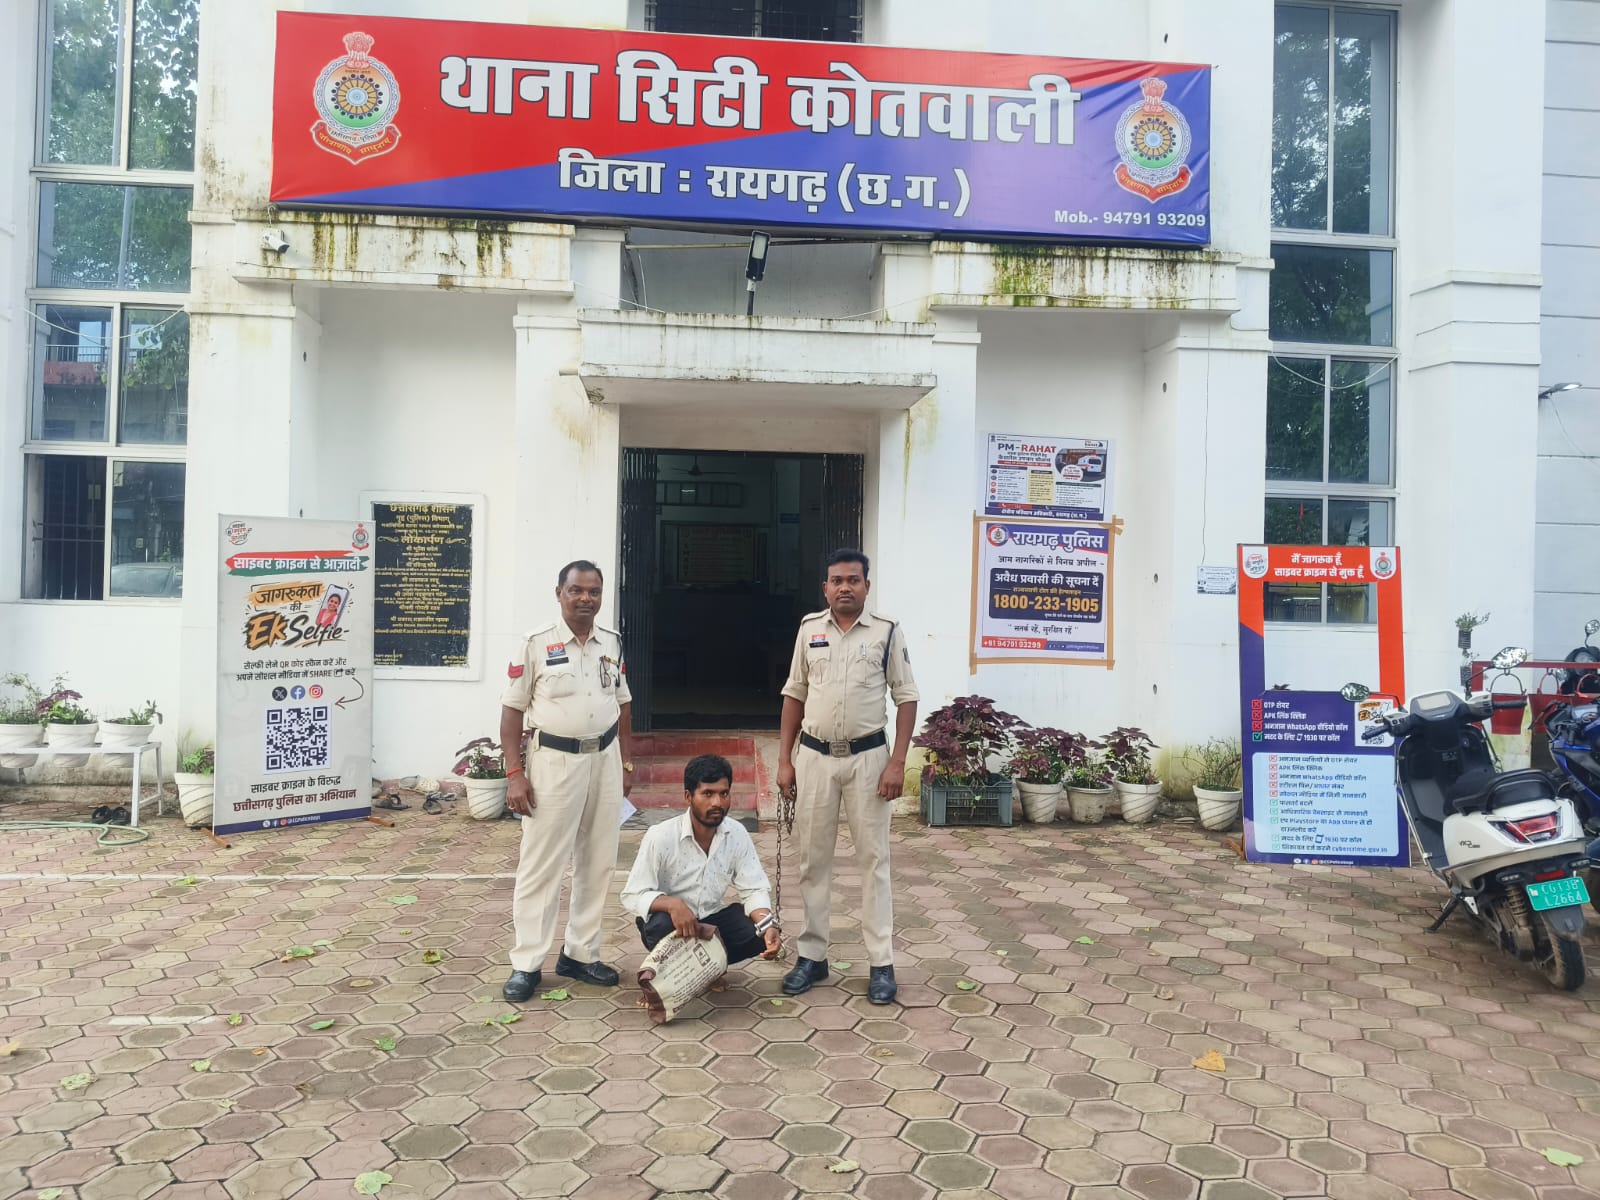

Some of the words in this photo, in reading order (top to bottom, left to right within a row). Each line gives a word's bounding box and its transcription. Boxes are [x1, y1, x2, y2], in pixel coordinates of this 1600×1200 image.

[439, 55, 599, 120] थाना
[615, 50, 769, 131] सिटी
[787, 61, 1082, 145] कोतवाली
[558, 147, 666, 194] जिला
[678, 170, 691, 194] :
[706, 165, 827, 214] रायगढ़
[837, 162, 972, 218] (छ.ग.)
[1054, 210, 1098, 225] Mob.-
[1103, 211, 1151, 226] 94791
[1158, 212, 1206, 227] 93209
[1012, 530, 1059, 550] रायगढ़
[1061, 530, 1105, 552] पुलिस
[233, 557, 271, 570] साइबर
[275, 558, 307, 570] क्राइम
[310, 556, 320, 570] से
[1015, 554, 1044, 565] नागरिकों
[1047, 555, 1053, 565] से
[1076, 558, 1097, 567] अपील
[1291, 553, 1300, 563] मैं
[1020, 572, 1049, 585] प्रवासी
[1051, 573, 1063, 585] की
[1065, 575, 1090, 588] सूचना
[1274, 568, 1302, 577] साइबर
[1303, 568, 1327, 577] क्राइम
[1329, 567, 1338, 577] से
[1357, 565, 1365, 579] हूँ
[255, 584, 323, 604] जागरुकता
[289, 602, 302, 612] की
[993, 594, 1099, 612] 1800-233-1905
[291, 660, 303, 668] कोड
[334, 657, 346, 666] और
[309, 669, 333, 678] SHARE
[1287, 723, 1316, 731] WhatsApp
[251, 781, 279, 794] साइबर
[281, 779, 305, 792] क्राइम
[307, 777, 317, 788] के
[318, 774, 341, 787] विरुद्ध
[233, 798, 274, 813] छत्तीसगढ़
[276, 794, 303, 809] पुलिस
[305, 793, 317, 804] का
[320, 788, 357, 801] अभियान
